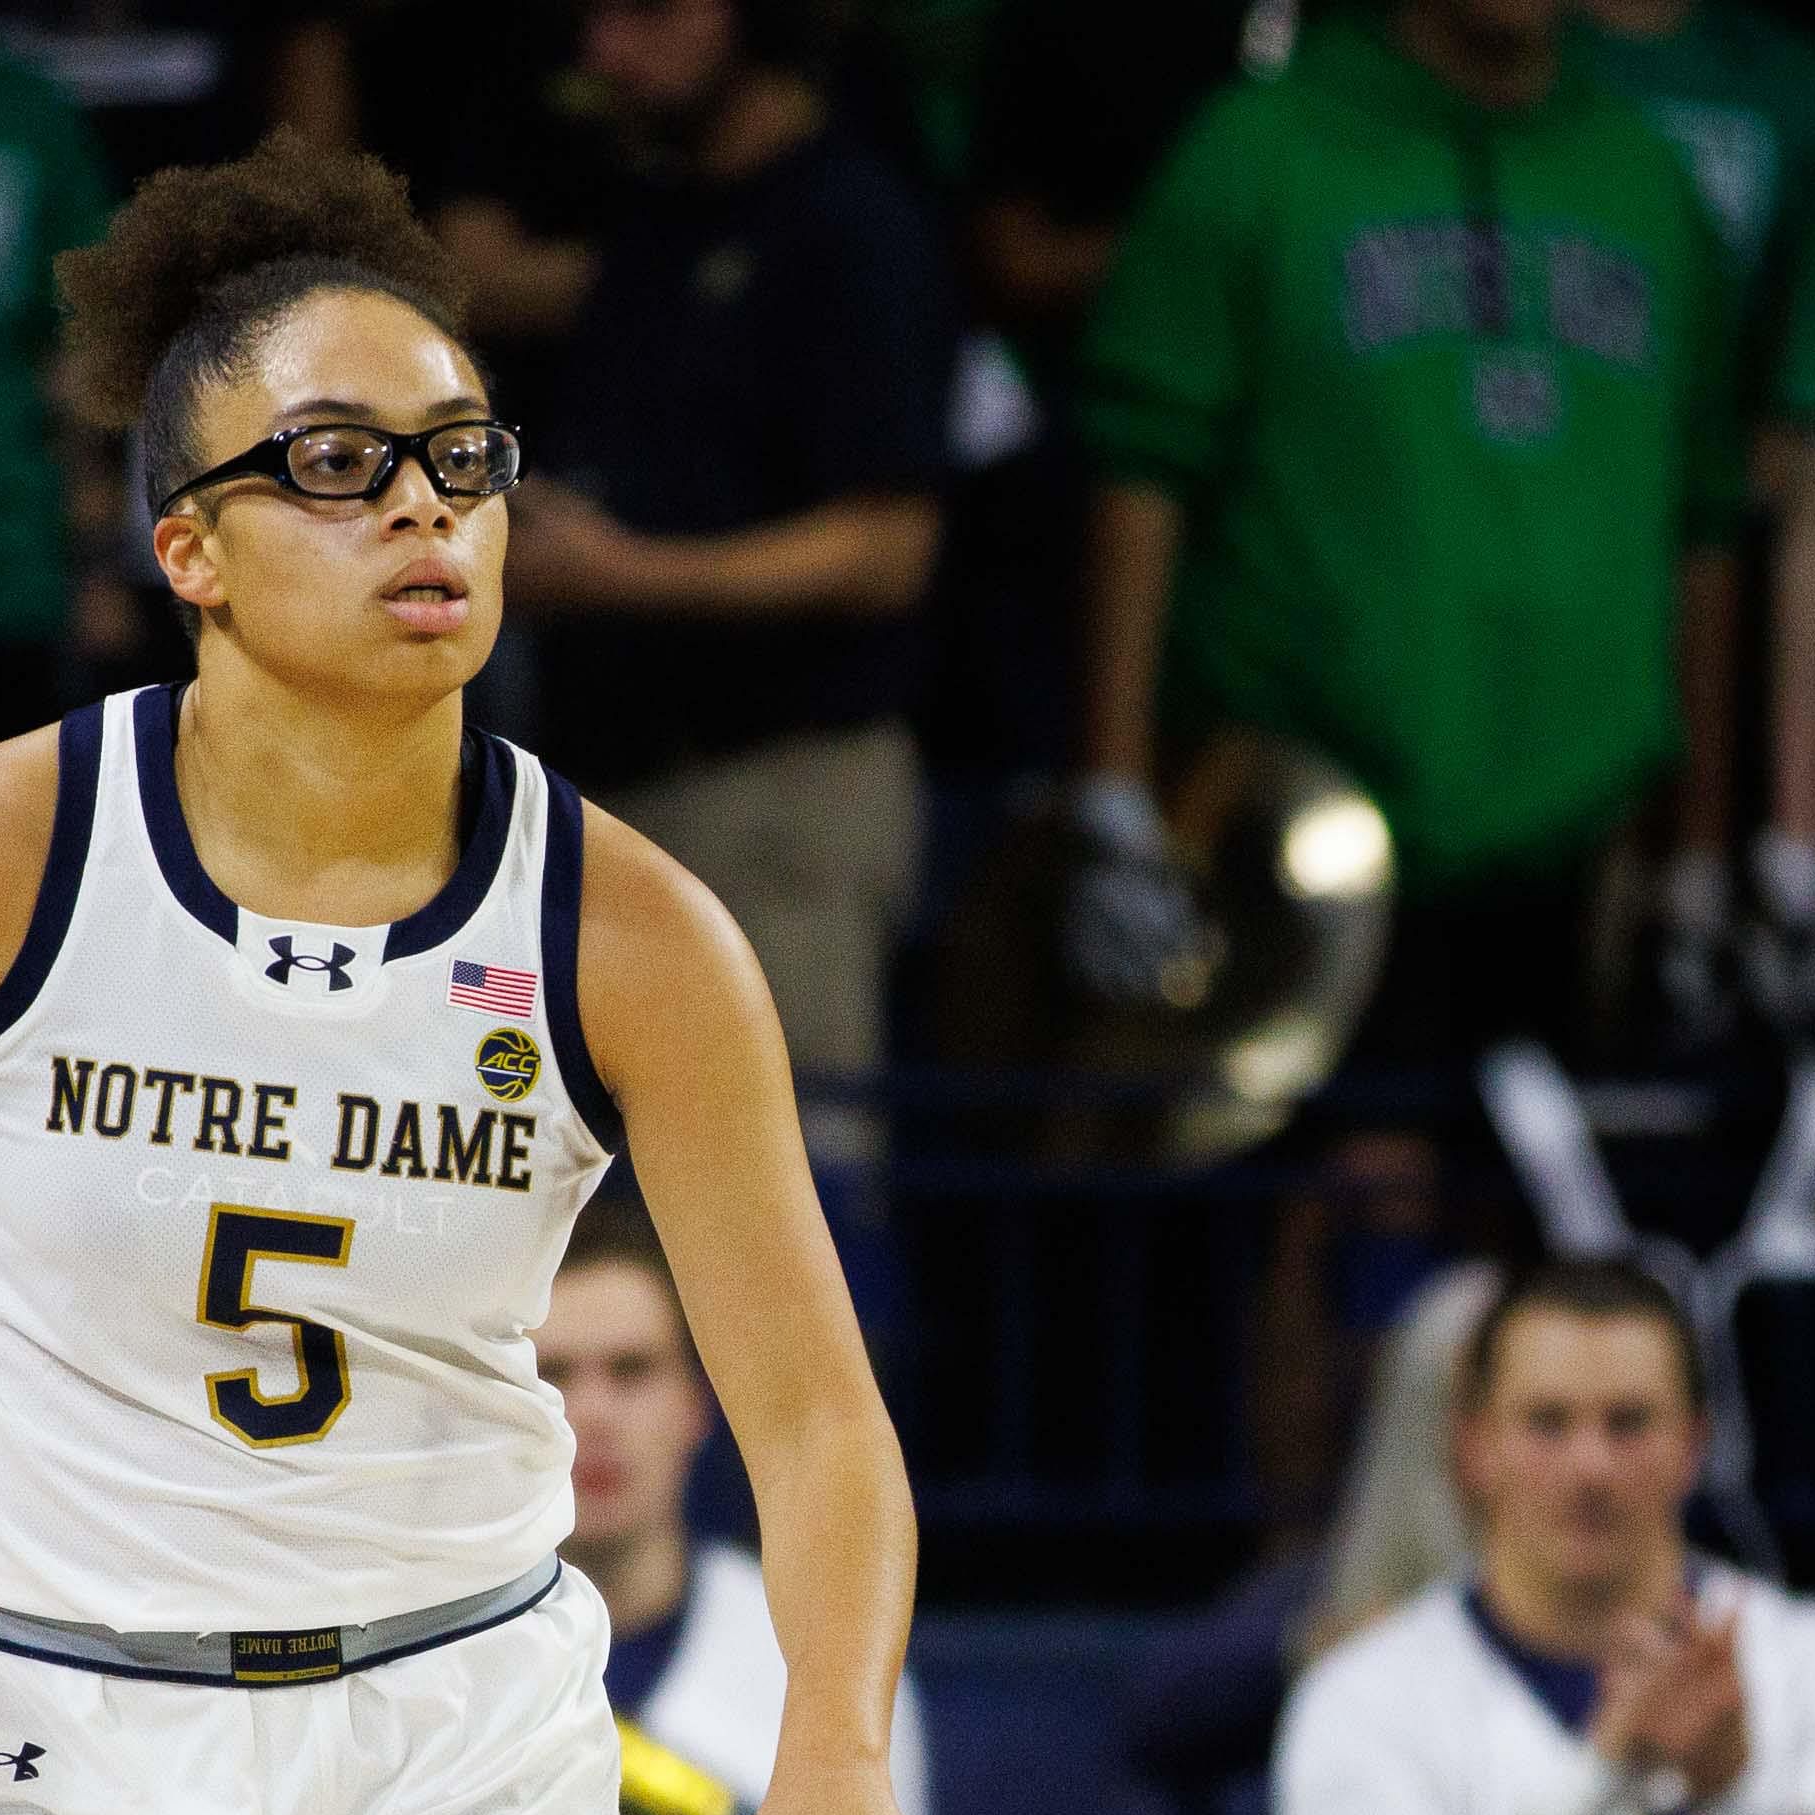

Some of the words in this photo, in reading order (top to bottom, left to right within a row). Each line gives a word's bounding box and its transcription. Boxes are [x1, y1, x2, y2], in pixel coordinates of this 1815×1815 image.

[45, 1055, 298, 1163] NOTRE
[330, 1093, 537, 1192] DAME
[482, 1051, 540, 1073] ACC
[196, 1203, 355, 1449] 5
